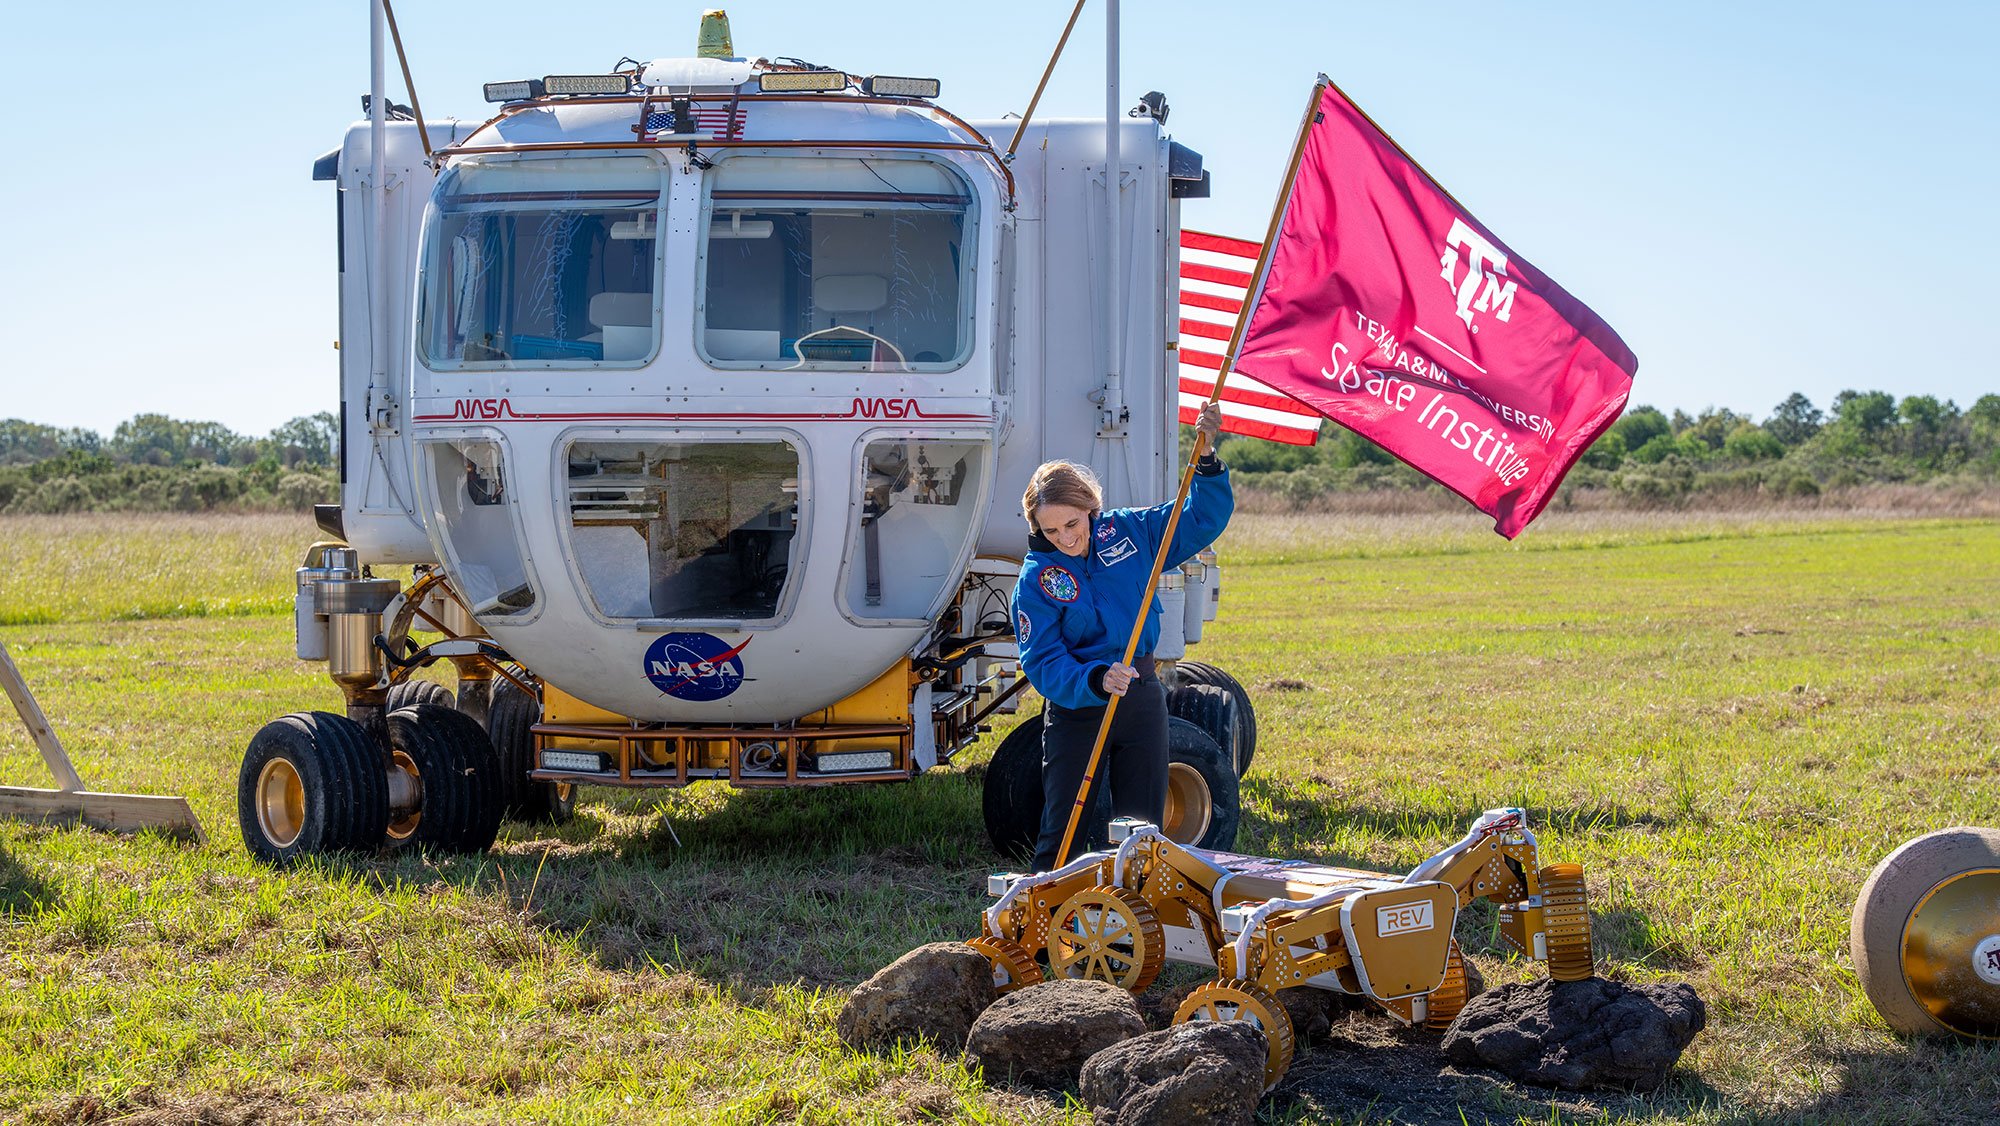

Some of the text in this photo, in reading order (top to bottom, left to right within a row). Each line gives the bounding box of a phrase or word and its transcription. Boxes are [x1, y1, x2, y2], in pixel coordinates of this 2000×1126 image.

[1356, 310, 1555, 444] TEXAS A&M VERSITY
[454, 398, 513, 419] NASA
[850, 397, 923, 418] NASA
[1321, 342, 1530, 486] Space Institute
[650, 660, 739, 677] NASA
[1387, 907, 1425, 930] REV
